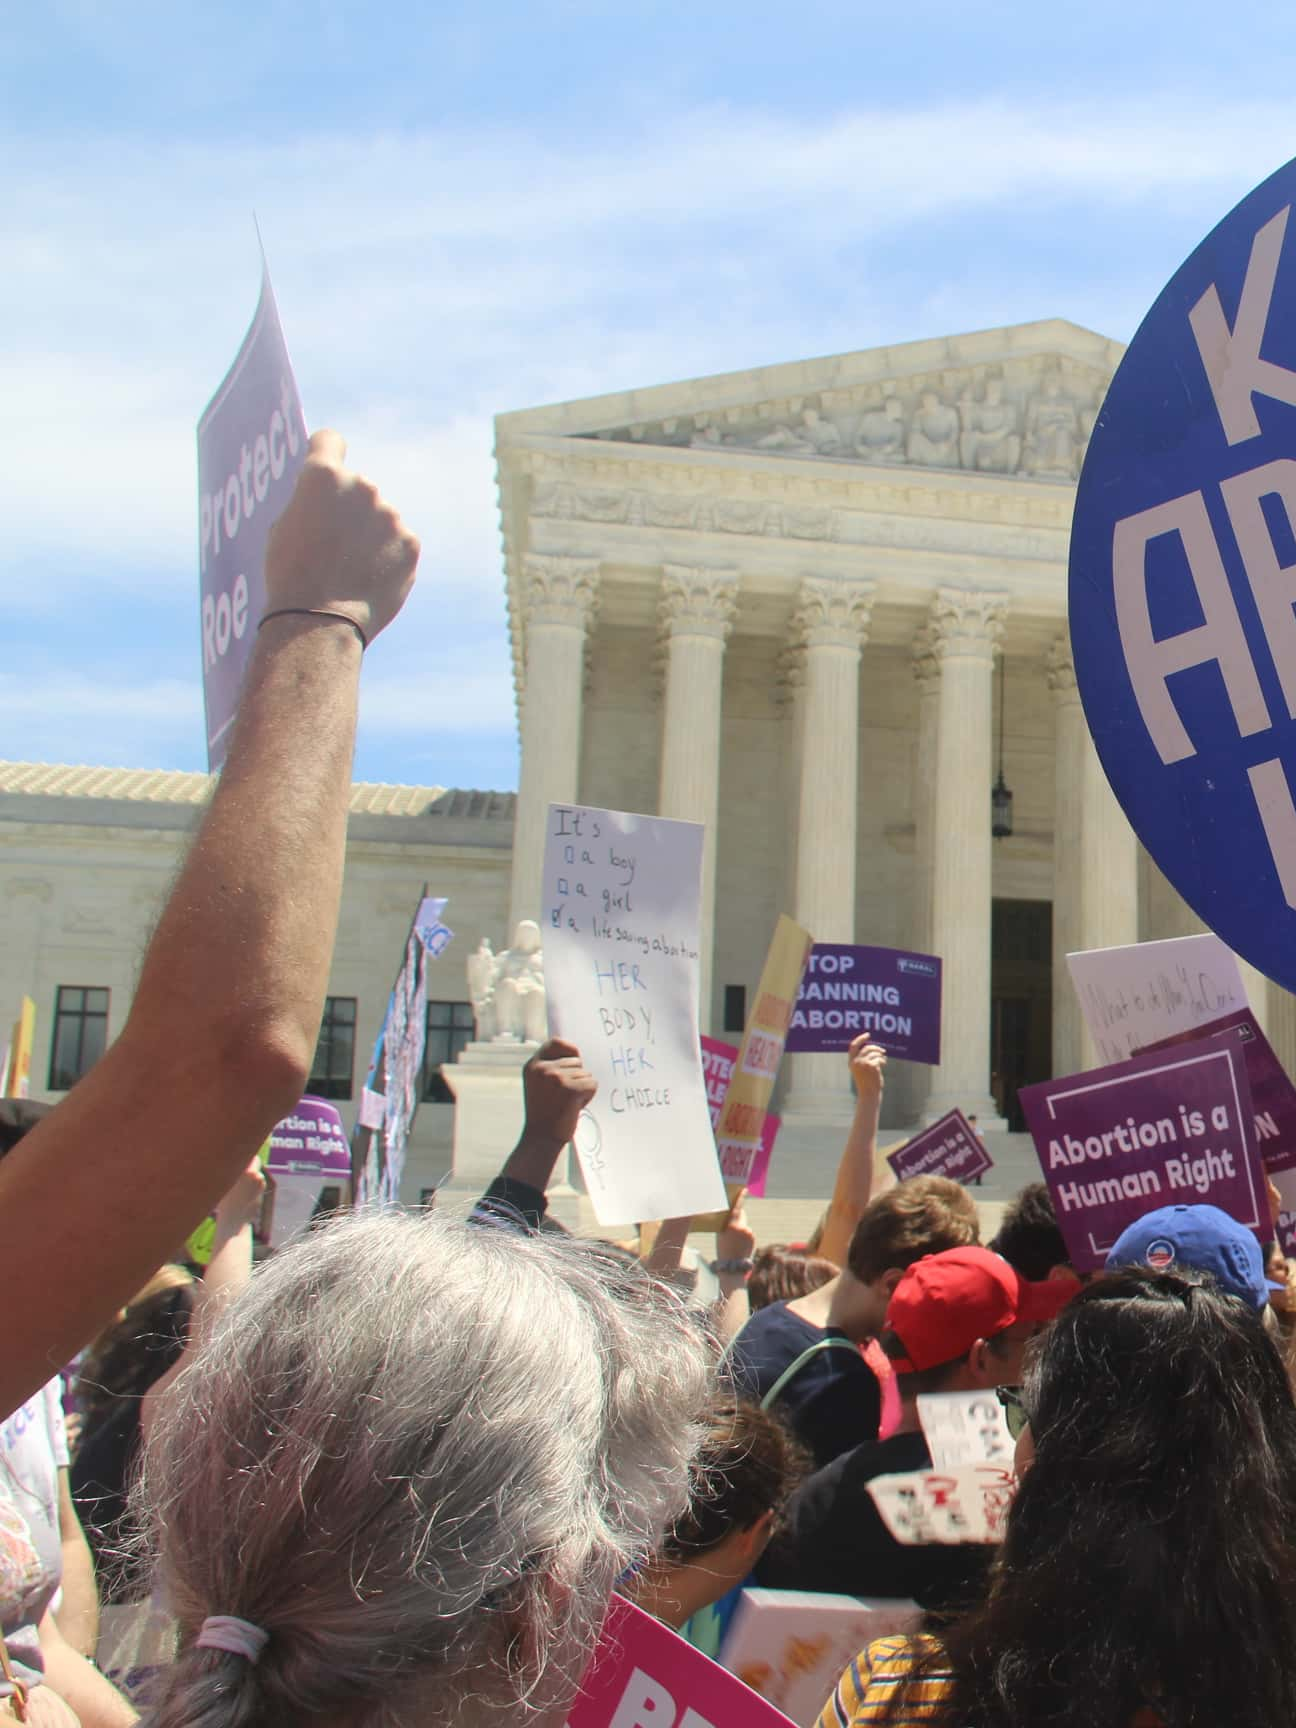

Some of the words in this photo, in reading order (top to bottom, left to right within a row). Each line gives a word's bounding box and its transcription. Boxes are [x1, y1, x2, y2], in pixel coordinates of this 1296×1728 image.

[201, 375, 299, 571] Protect
[203, 574, 249, 674] Roe
[554, 809, 601, 838] It's
[582, 851, 595, 864] a
[609, 848, 636, 886] boy
[576, 883, 588, 896] a
[602, 888, 632, 913] girl
[568, 917, 580, 933] a
[594, 960, 647, 996] HER
[808, 954, 855, 974] TOP
[790, 1010, 912, 1036] ABORTION
[610, 1046, 654, 1077] HER
[610, 1087, 671, 1113] CHOICE
[279, 1115, 317, 1132] rtion
[1049, 1117, 1177, 1169] Abortion
[1178, 1104, 1206, 1138] is
[1211, 1105, 1229, 1131] a
[271, 1136, 304, 1149] man
[1057, 1168, 1161, 1212] Human
[1165, 1148, 1236, 1195] Right
